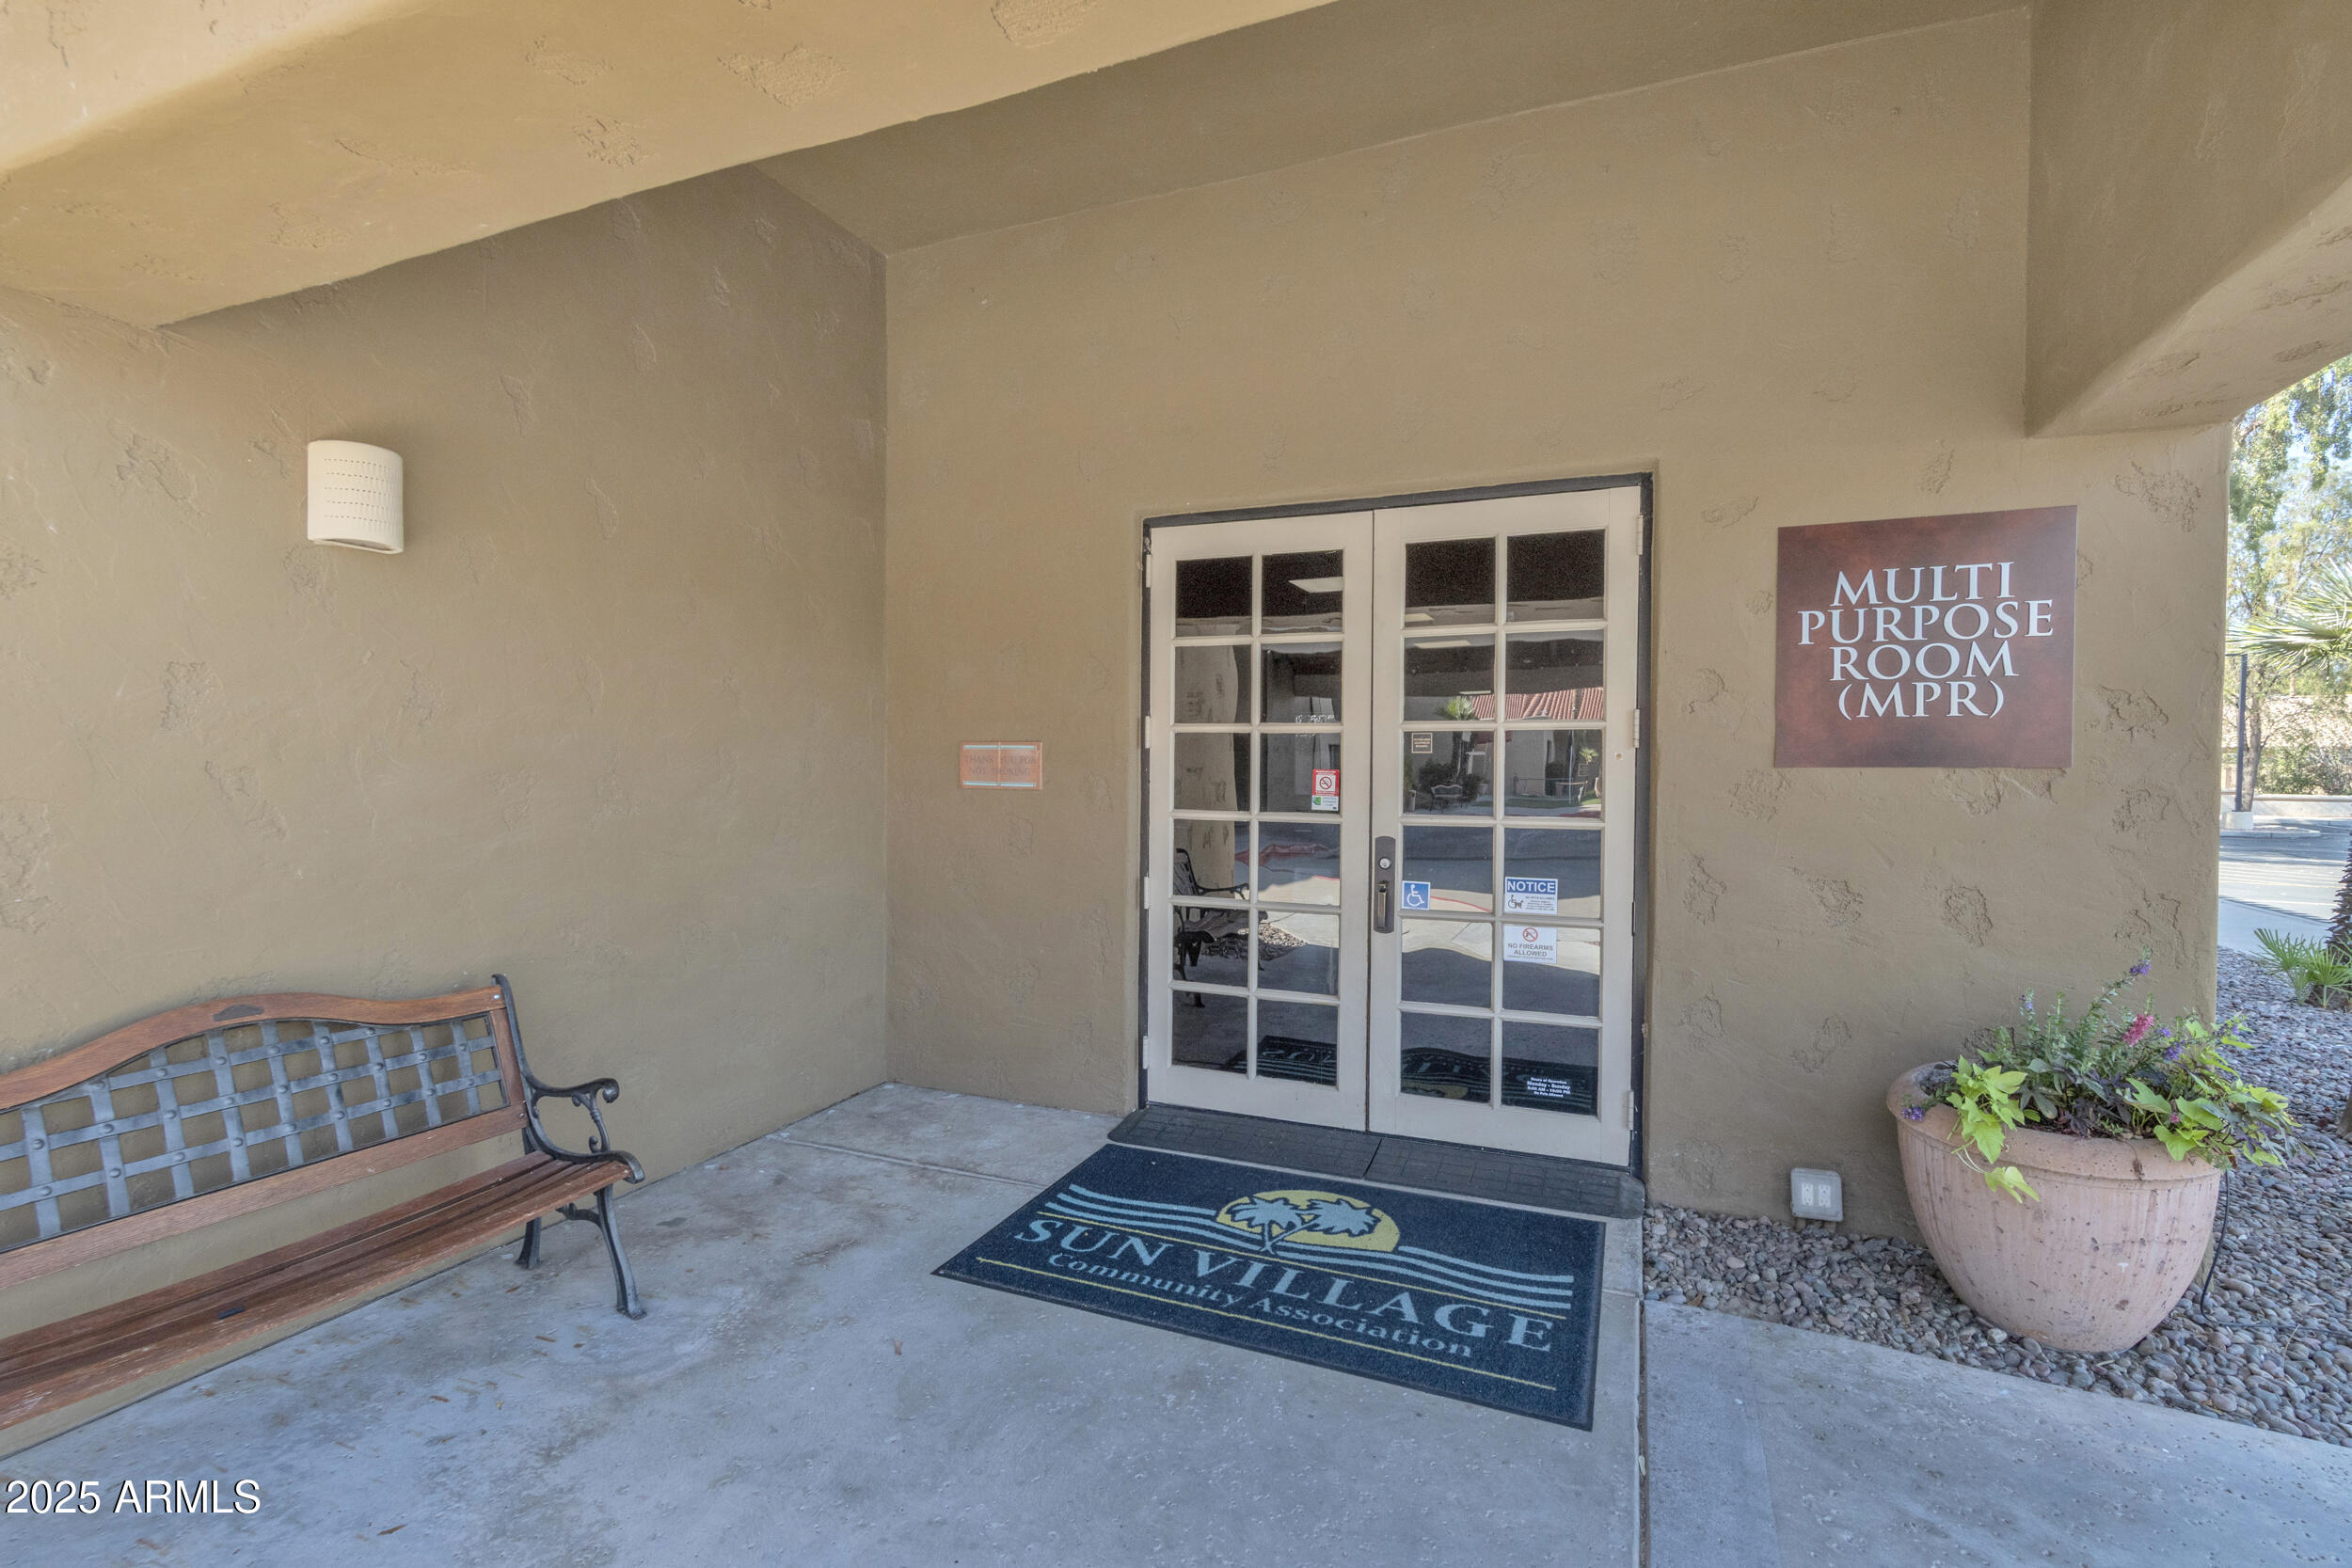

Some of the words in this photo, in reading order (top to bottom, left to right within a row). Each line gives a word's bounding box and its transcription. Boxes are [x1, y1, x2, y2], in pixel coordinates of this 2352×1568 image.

[1830, 562, 2015, 607] MULTI
[1797, 599, 2054, 645] PURPOSE
[1829, 640, 2019, 681] ROOM
[1838, 680, 2005, 721] (MPR)
[1507, 880, 1555, 893] NOTICE
[1014, 1219, 1174, 1267] SUN
[1195, 1249, 1556, 1352] VILLAGE
[1048, 1253, 1240, 1308] Community
[1248, 1297, 1474, 1357] Association
